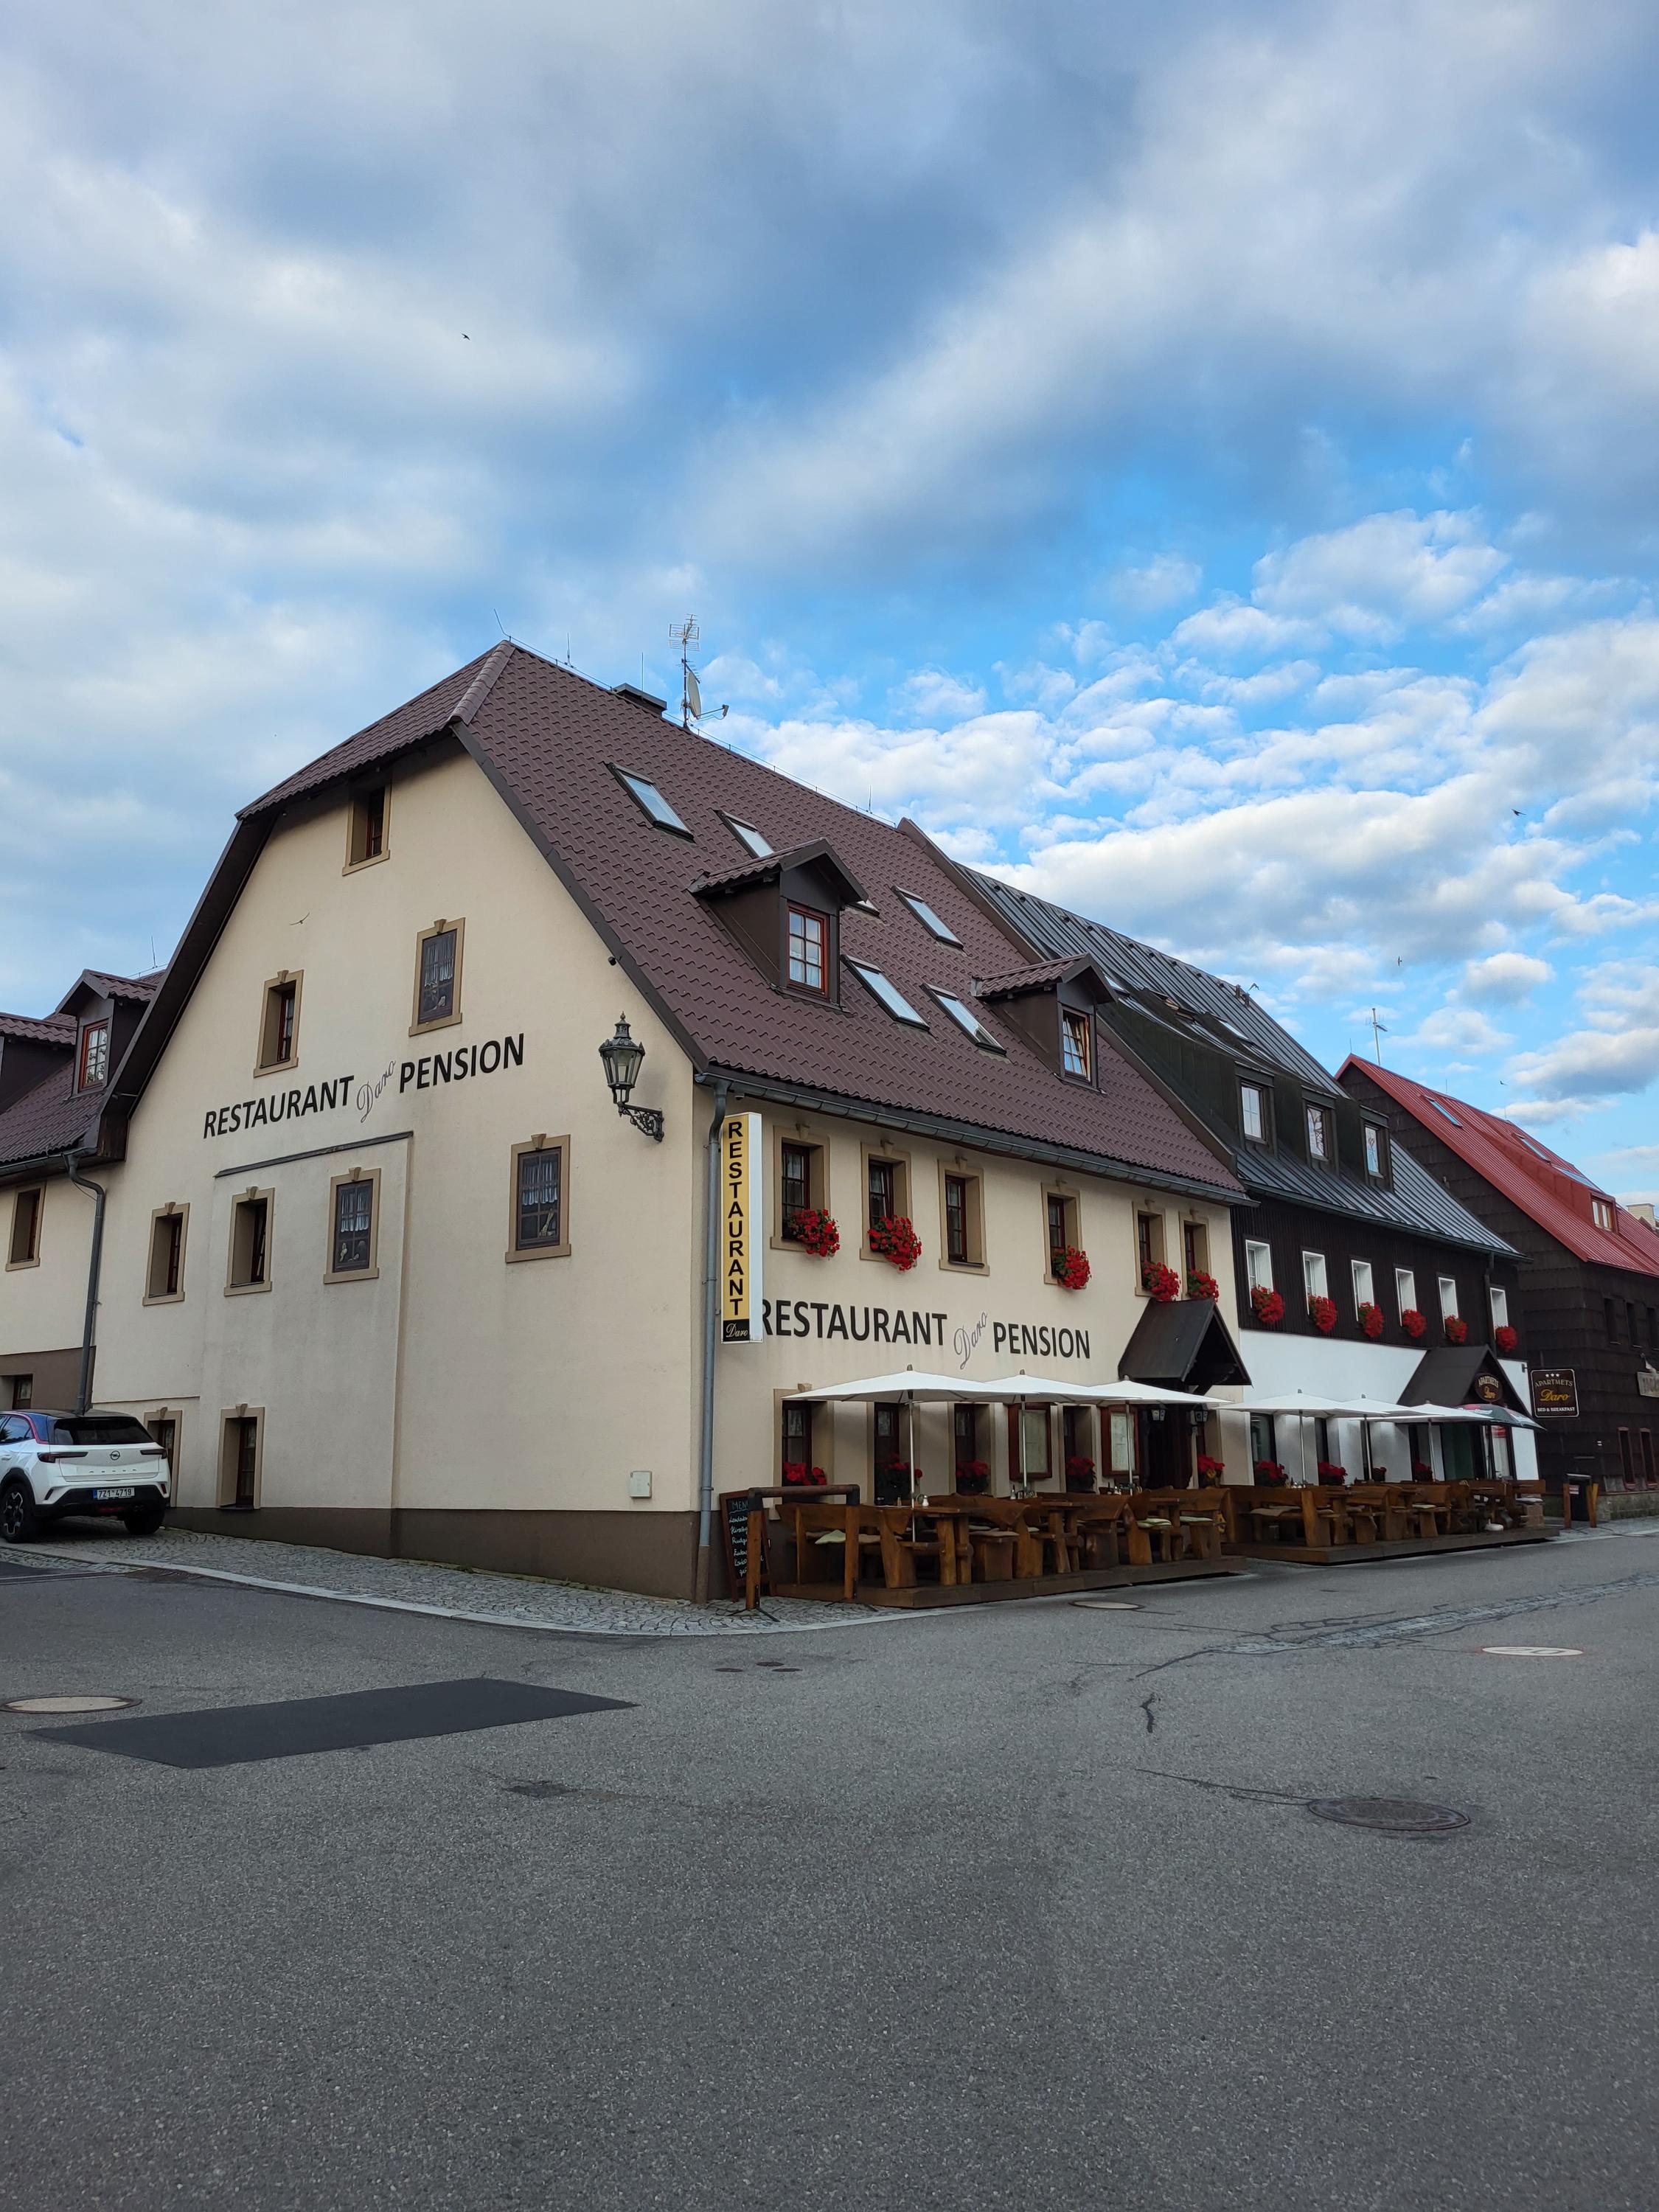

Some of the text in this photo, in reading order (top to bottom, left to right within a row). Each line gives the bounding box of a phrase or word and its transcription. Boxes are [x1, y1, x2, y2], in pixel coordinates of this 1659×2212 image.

[204, 1033, 525, 1139] RESTAURANT Daro PENSION
[728, 1121, 744, 1316] RESTAURANT
[726, 1323, 748, 1338] Daro
[953, 1311, 988, 1369] Daro
[993, 1321, 1091, 1359] PENSION
[1534, 1379, 1573, 1387] APARTMETS
[1540, 1388, 1570, 1402] Daro
[732, 1500, 748, 1509] MEN
